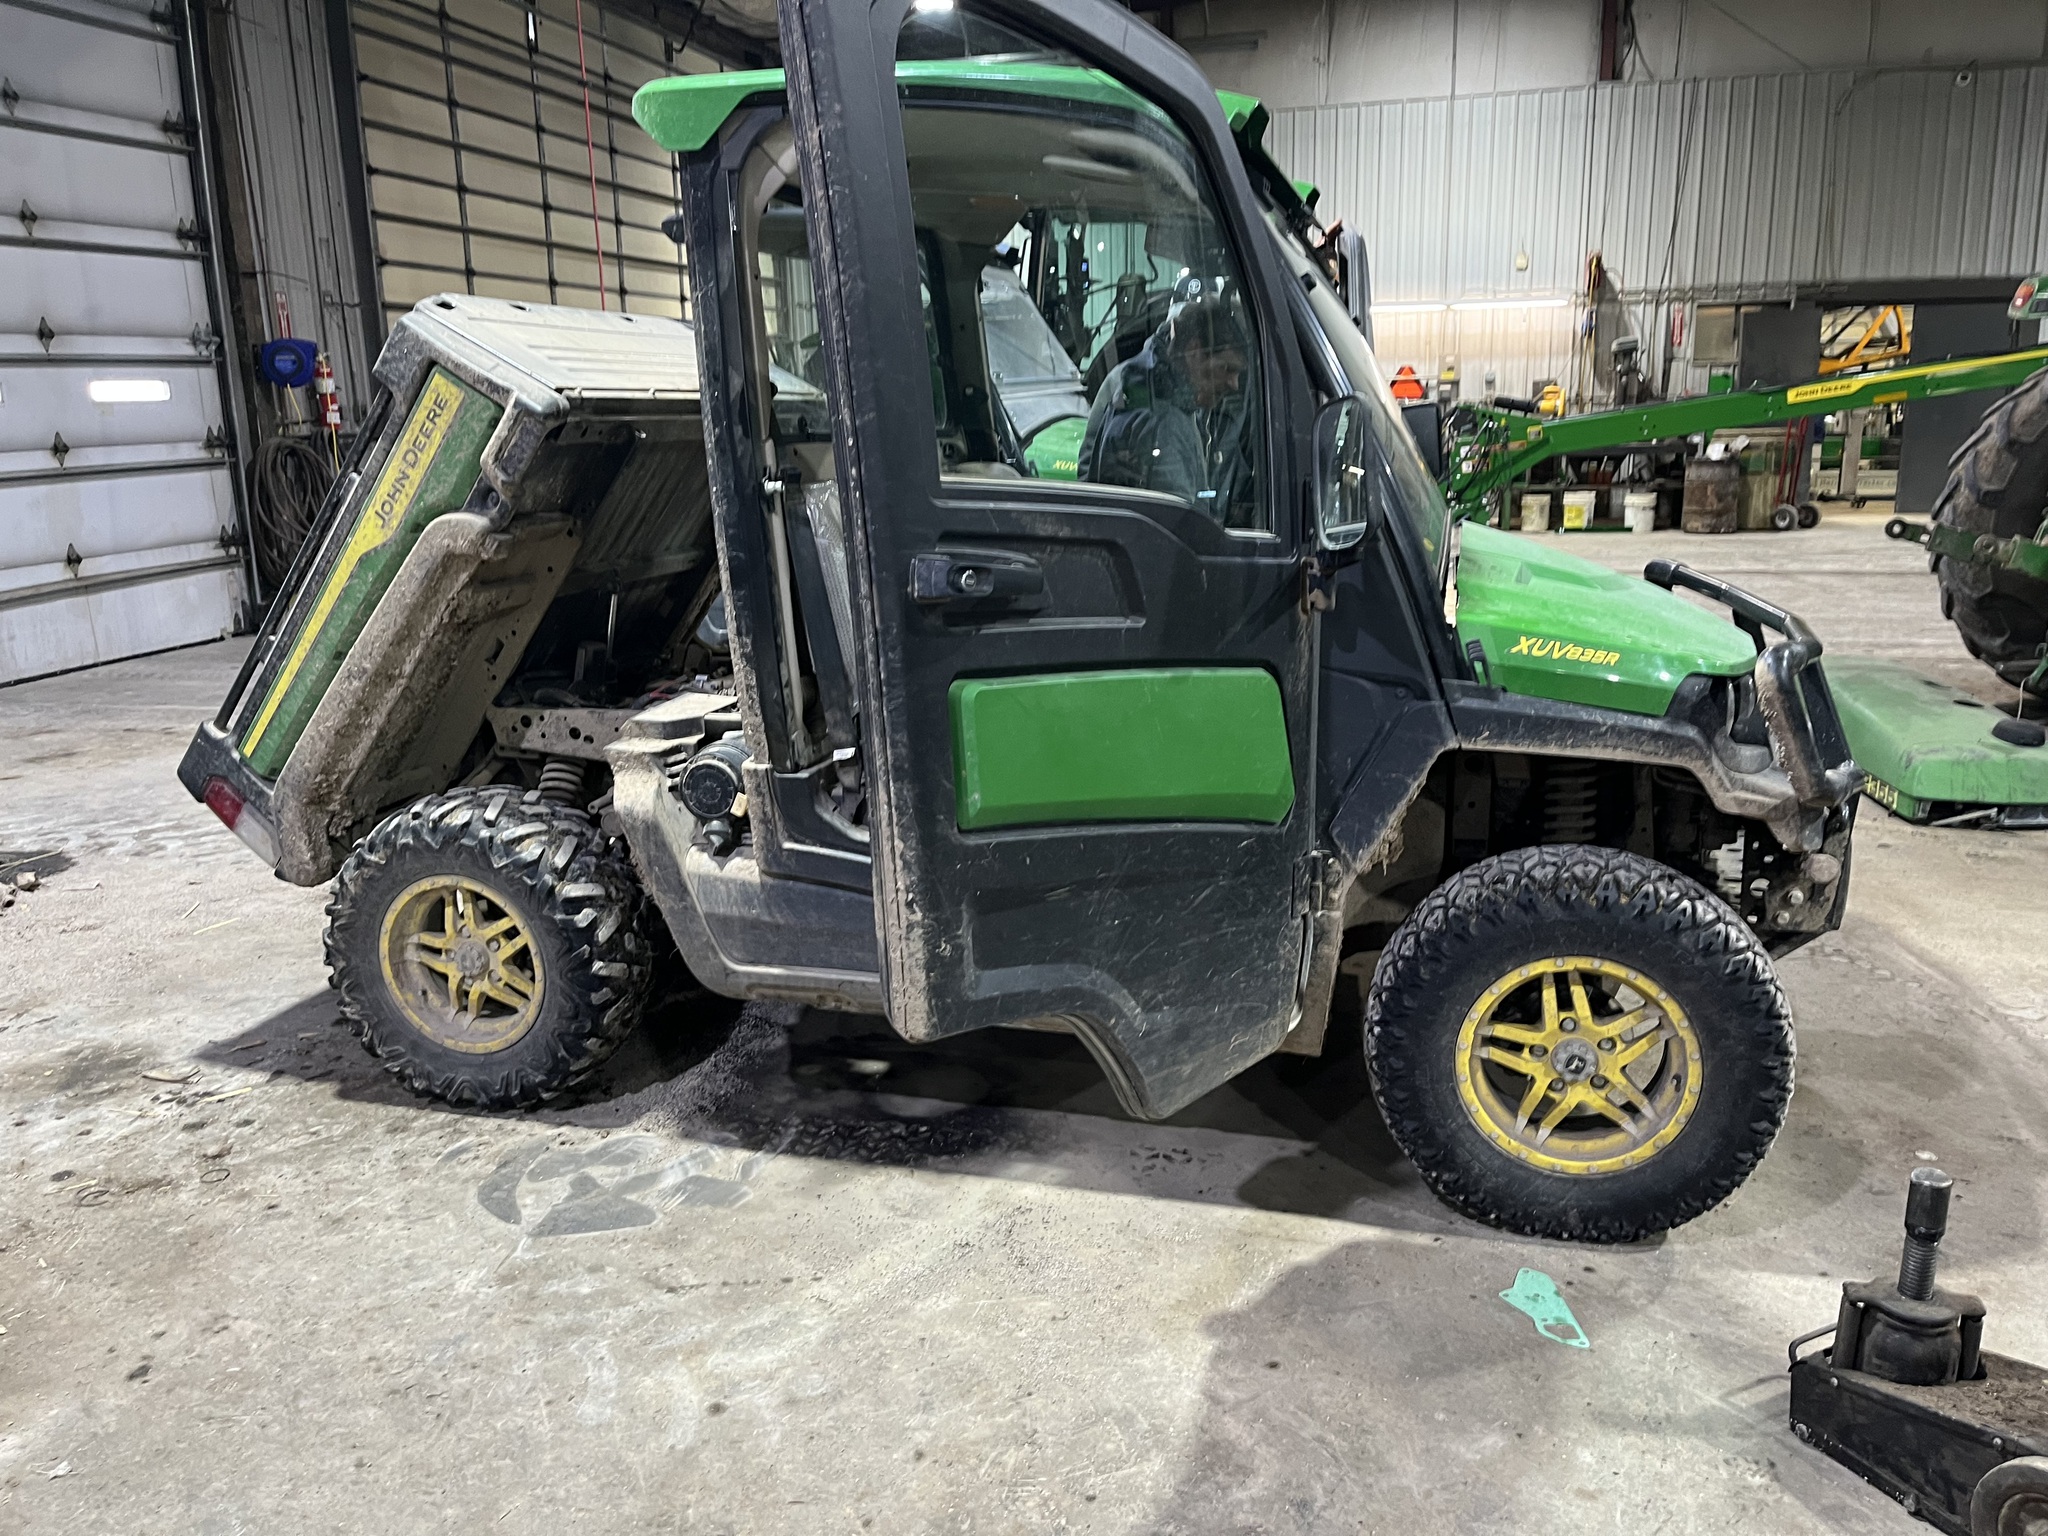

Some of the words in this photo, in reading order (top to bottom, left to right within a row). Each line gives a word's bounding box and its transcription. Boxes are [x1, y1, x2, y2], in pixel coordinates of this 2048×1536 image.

[374, 467, 411, 529] JOHN
[402, 392, 449, 470] DEERE
[1509, 635, 1621, 667] XUV835R
